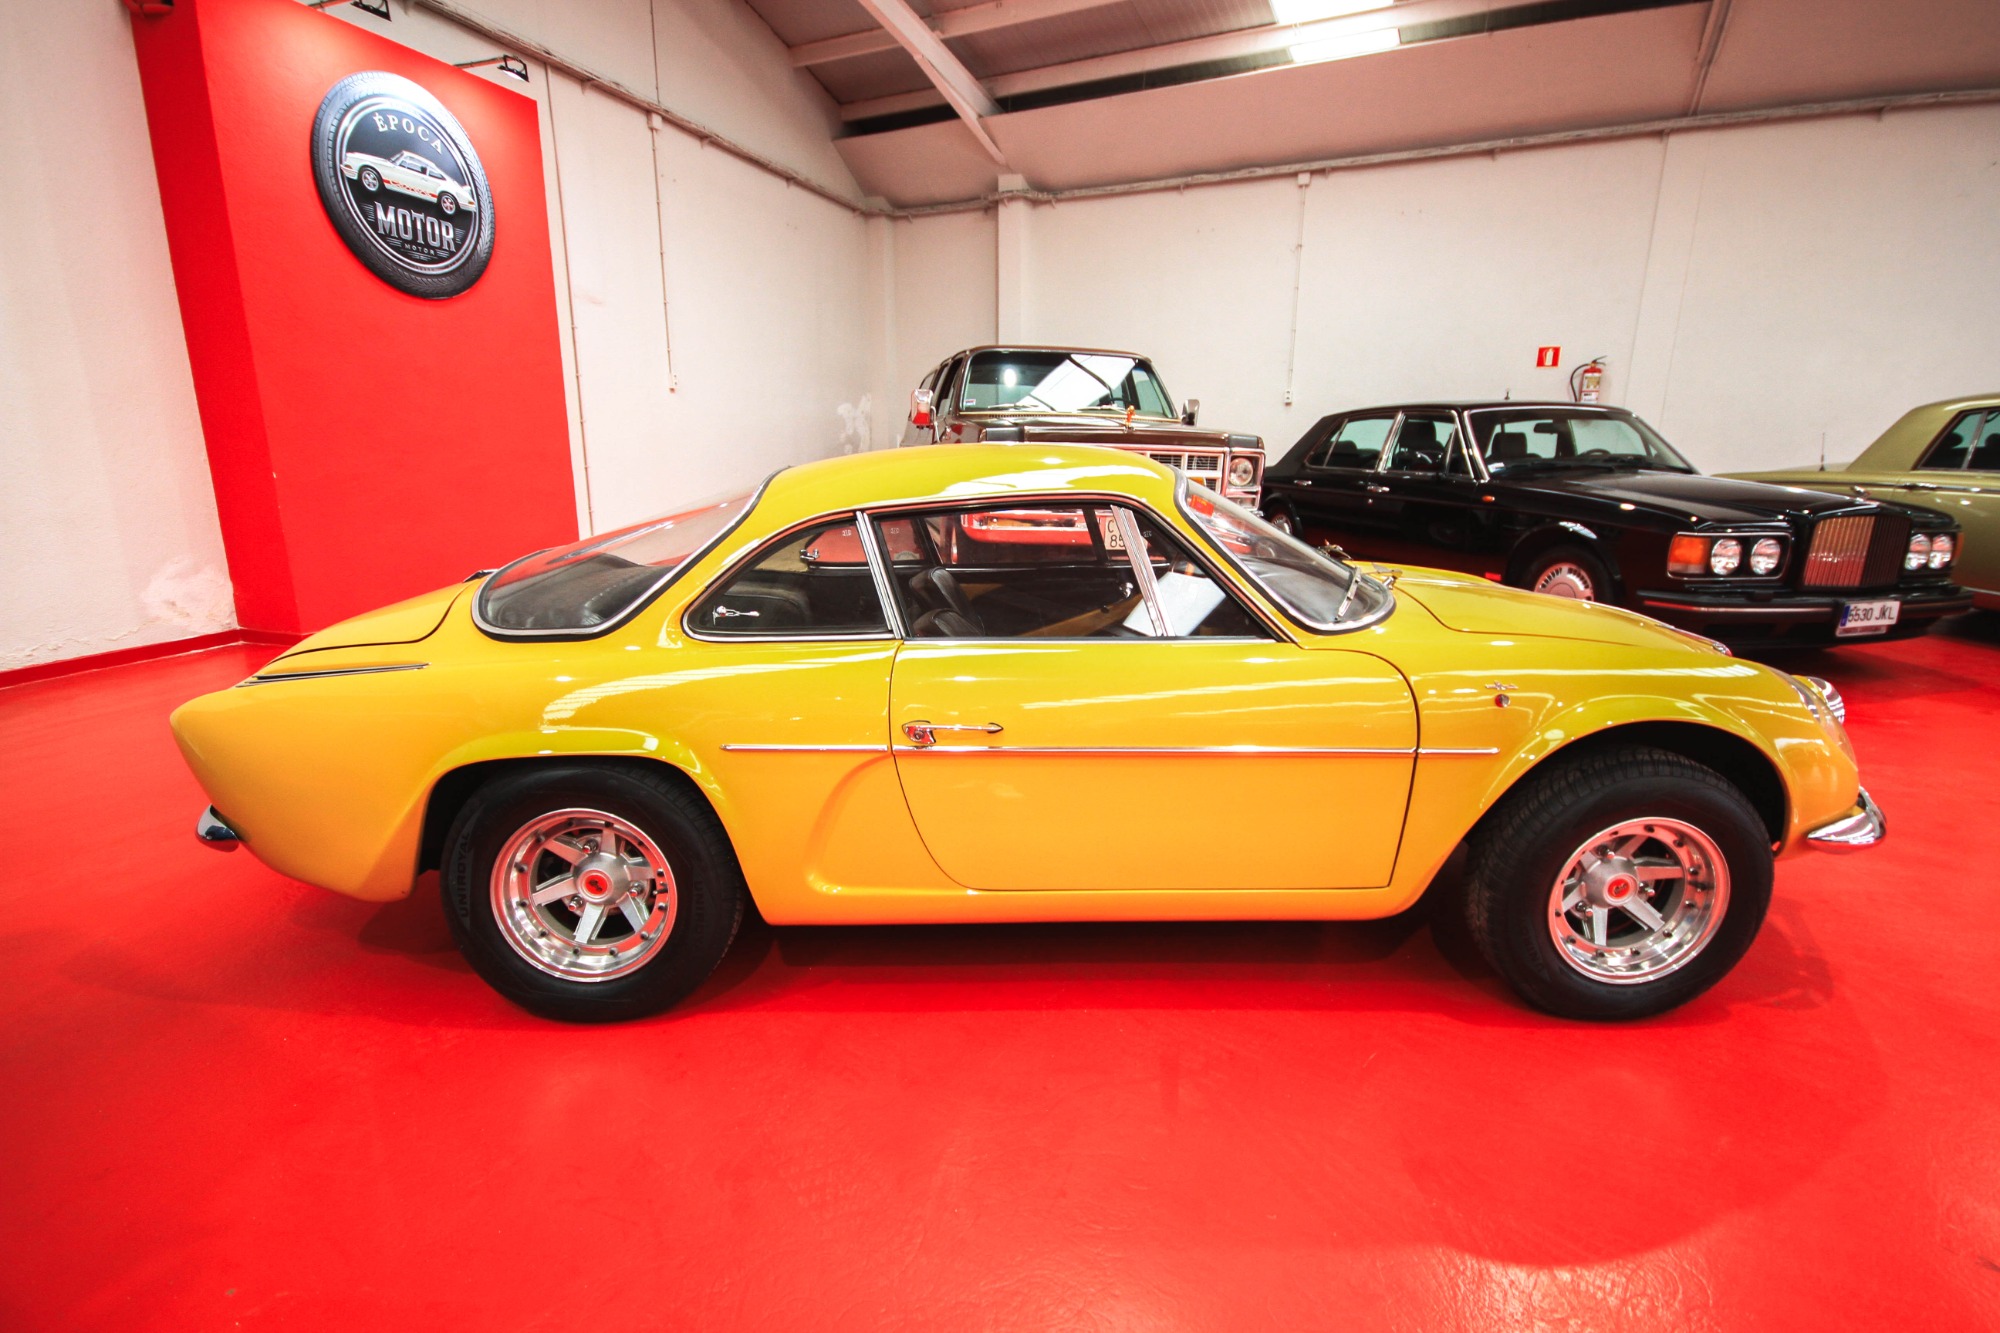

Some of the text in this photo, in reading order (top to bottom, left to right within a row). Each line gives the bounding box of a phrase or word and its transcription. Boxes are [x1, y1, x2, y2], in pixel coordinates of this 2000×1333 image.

[373, 111, 442, 154] ÉPOCA
[374, 201, 457, 252] MOTOR
[404, 243, 435, 255] MOTOR
[1875, 605, 1894, 621] JKL
[456, 831, 470, 919] UNIROYAL
